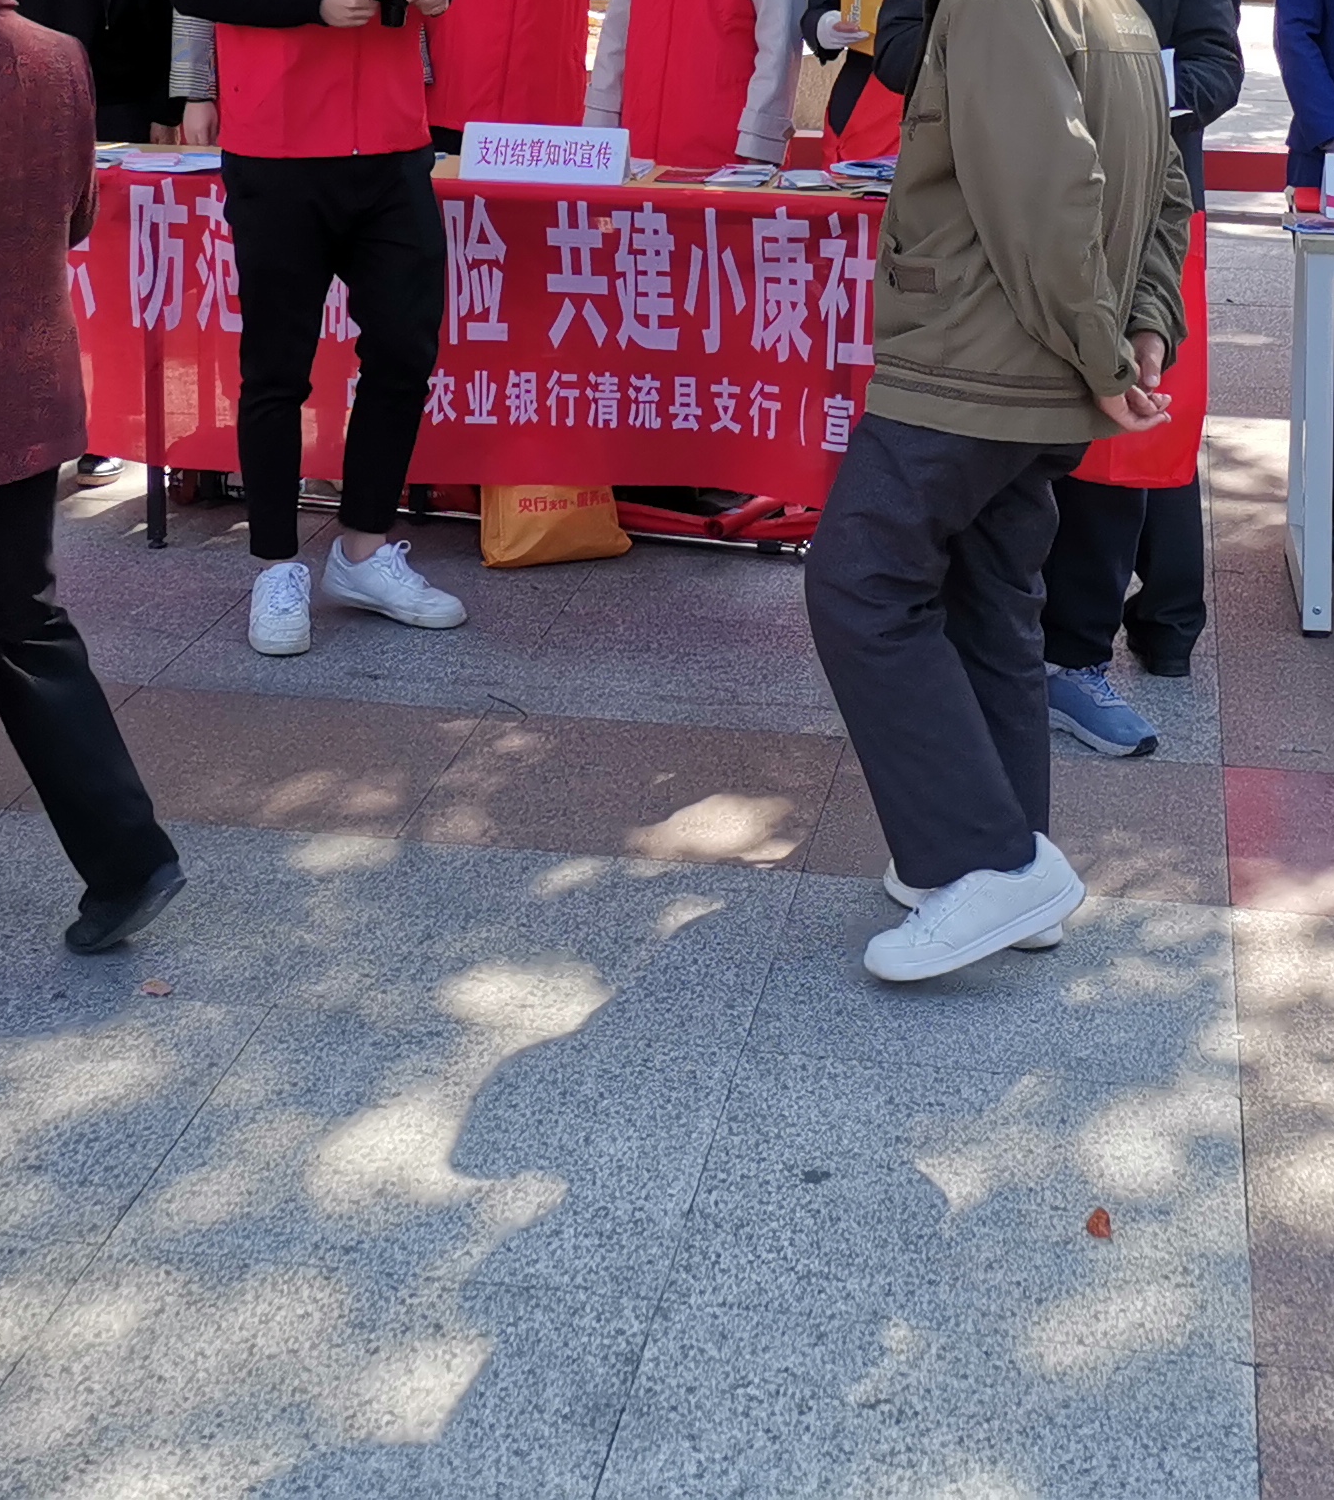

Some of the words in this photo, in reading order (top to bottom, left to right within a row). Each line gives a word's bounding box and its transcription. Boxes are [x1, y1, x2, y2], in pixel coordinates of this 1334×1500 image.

[475, 137, 613, 172] 支付结算知识宣传
